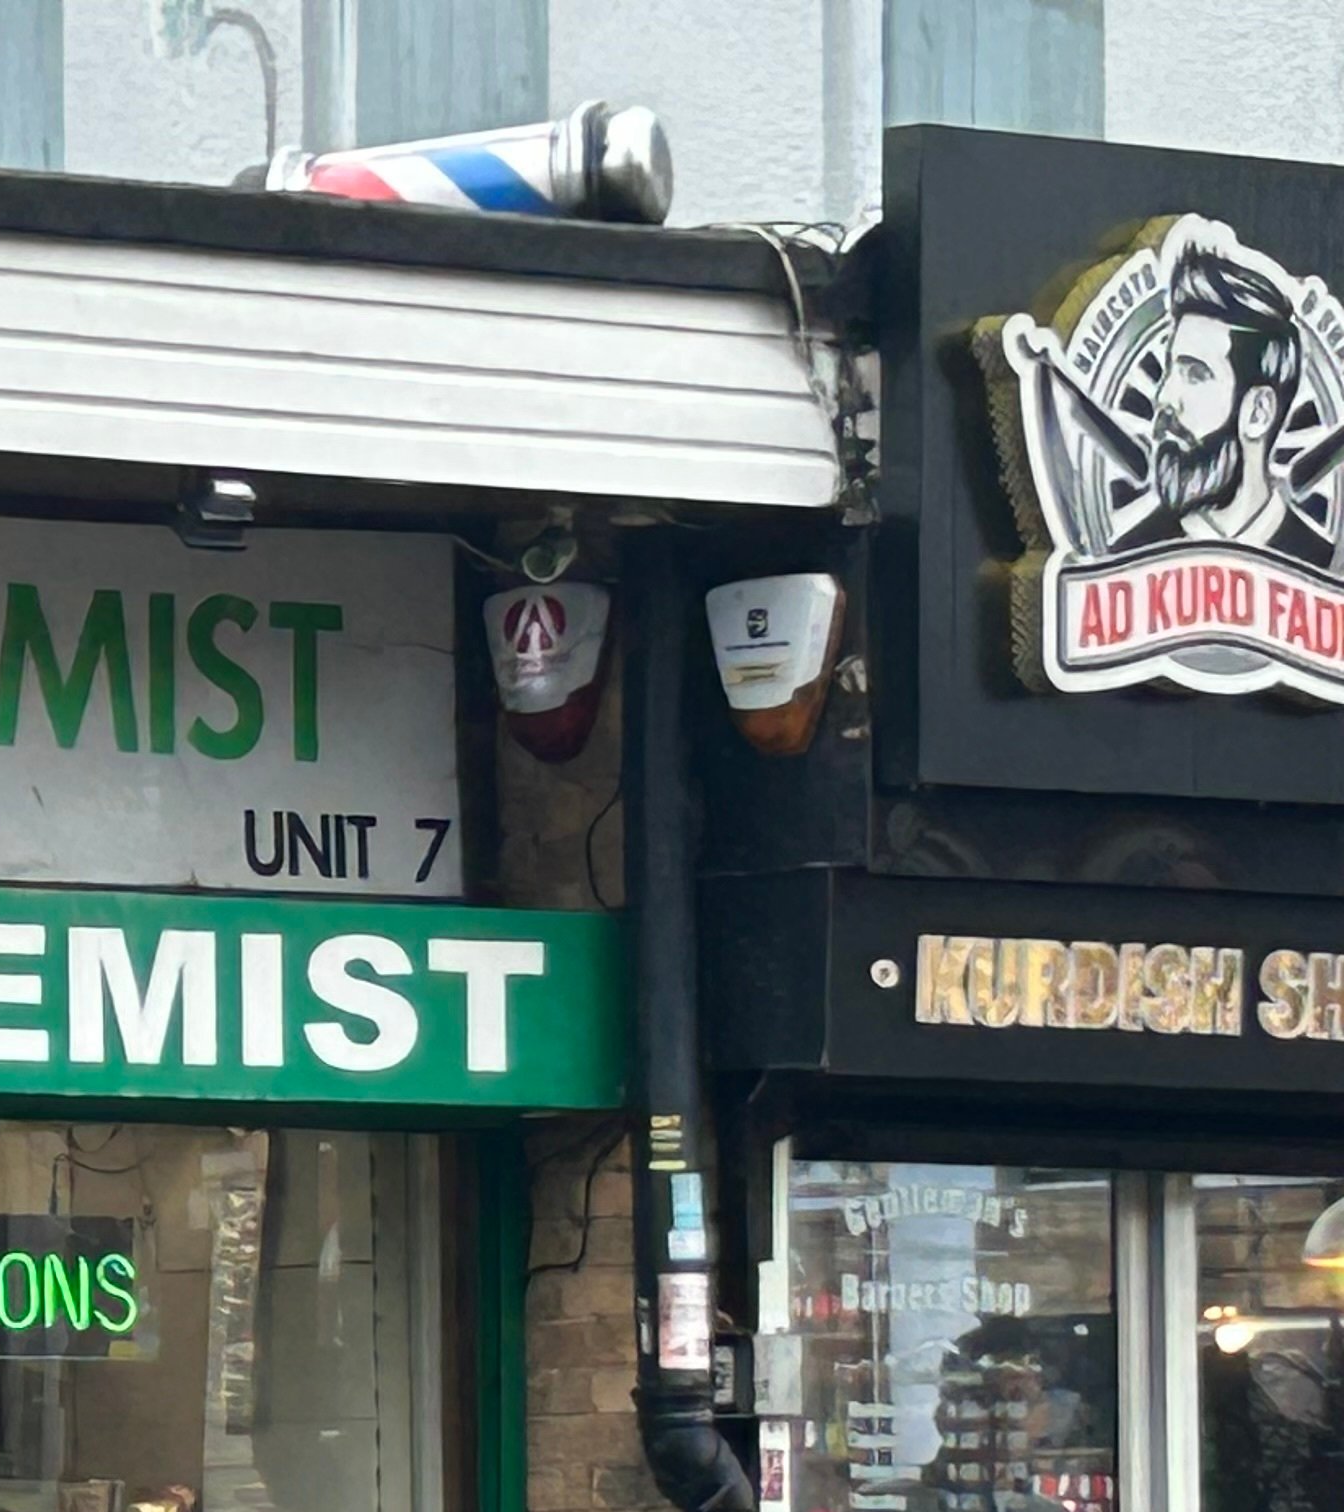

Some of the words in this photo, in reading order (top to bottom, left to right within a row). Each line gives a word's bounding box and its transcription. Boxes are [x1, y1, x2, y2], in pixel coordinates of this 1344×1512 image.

[1078, 580, 1134, 648] AD
[1147, 565, 1255, 635] KURD
[1268, 579, 1344, 662] FAD
[243, 810, 377, 881] UNIT
[414, 818, 451, 883] 7
[915, 934, 1244, 1037] KURDISH
[962, 1275, 1031, 1318] Shop
